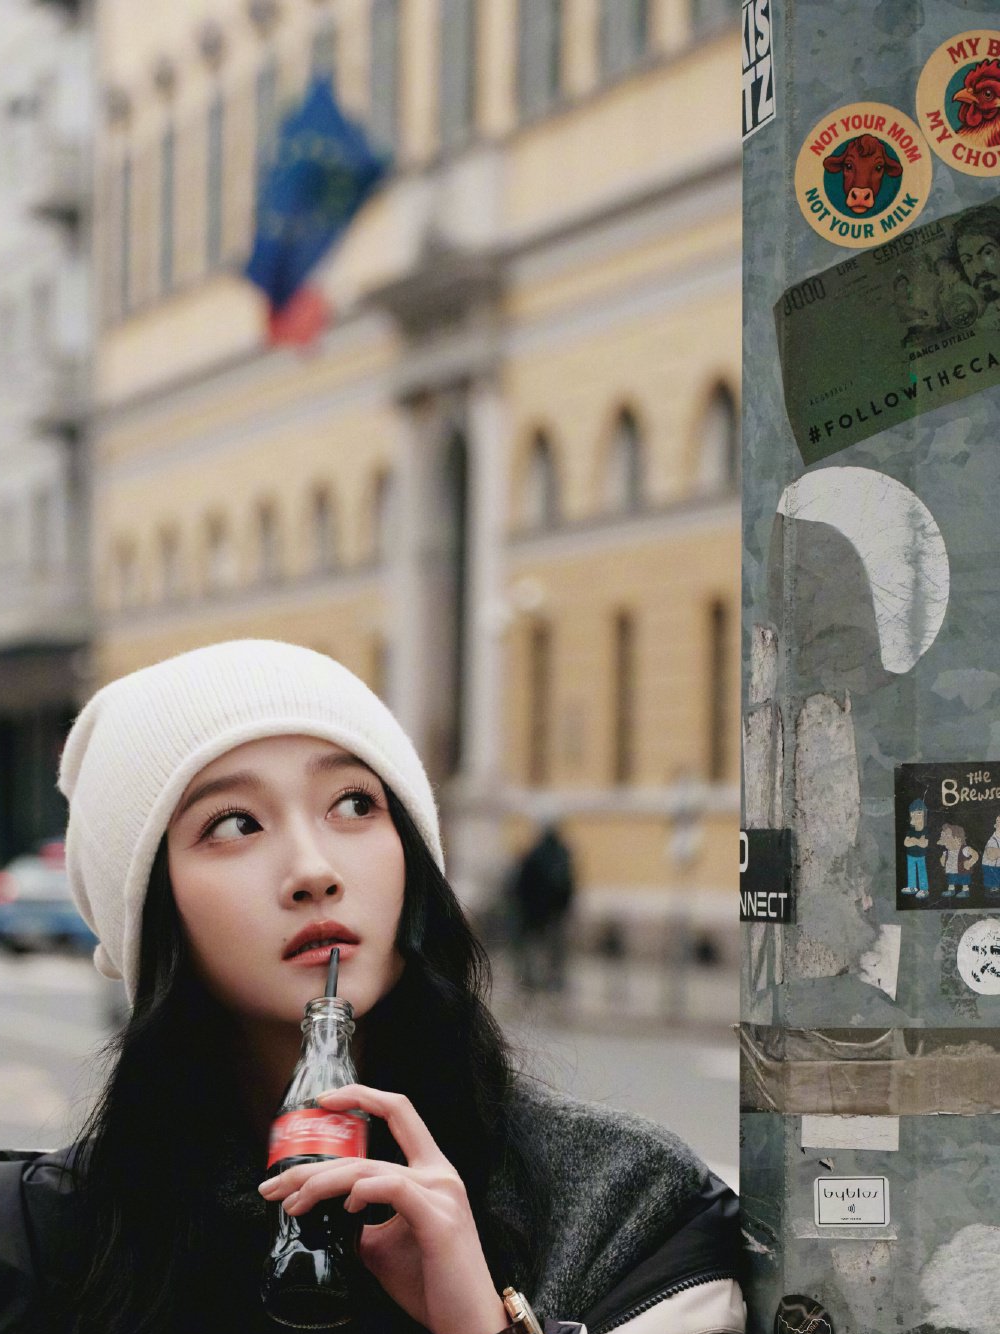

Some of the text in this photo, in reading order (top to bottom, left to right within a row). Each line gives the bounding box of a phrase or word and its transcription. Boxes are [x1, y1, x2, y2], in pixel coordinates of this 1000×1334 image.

[946, 37, 981, 64] MY
[809, 114, 922, 164] NOT YOUR MOM
[926, 110, 953, 144] MY
[805, 187, 919, 239] NOT YOUR MILK
